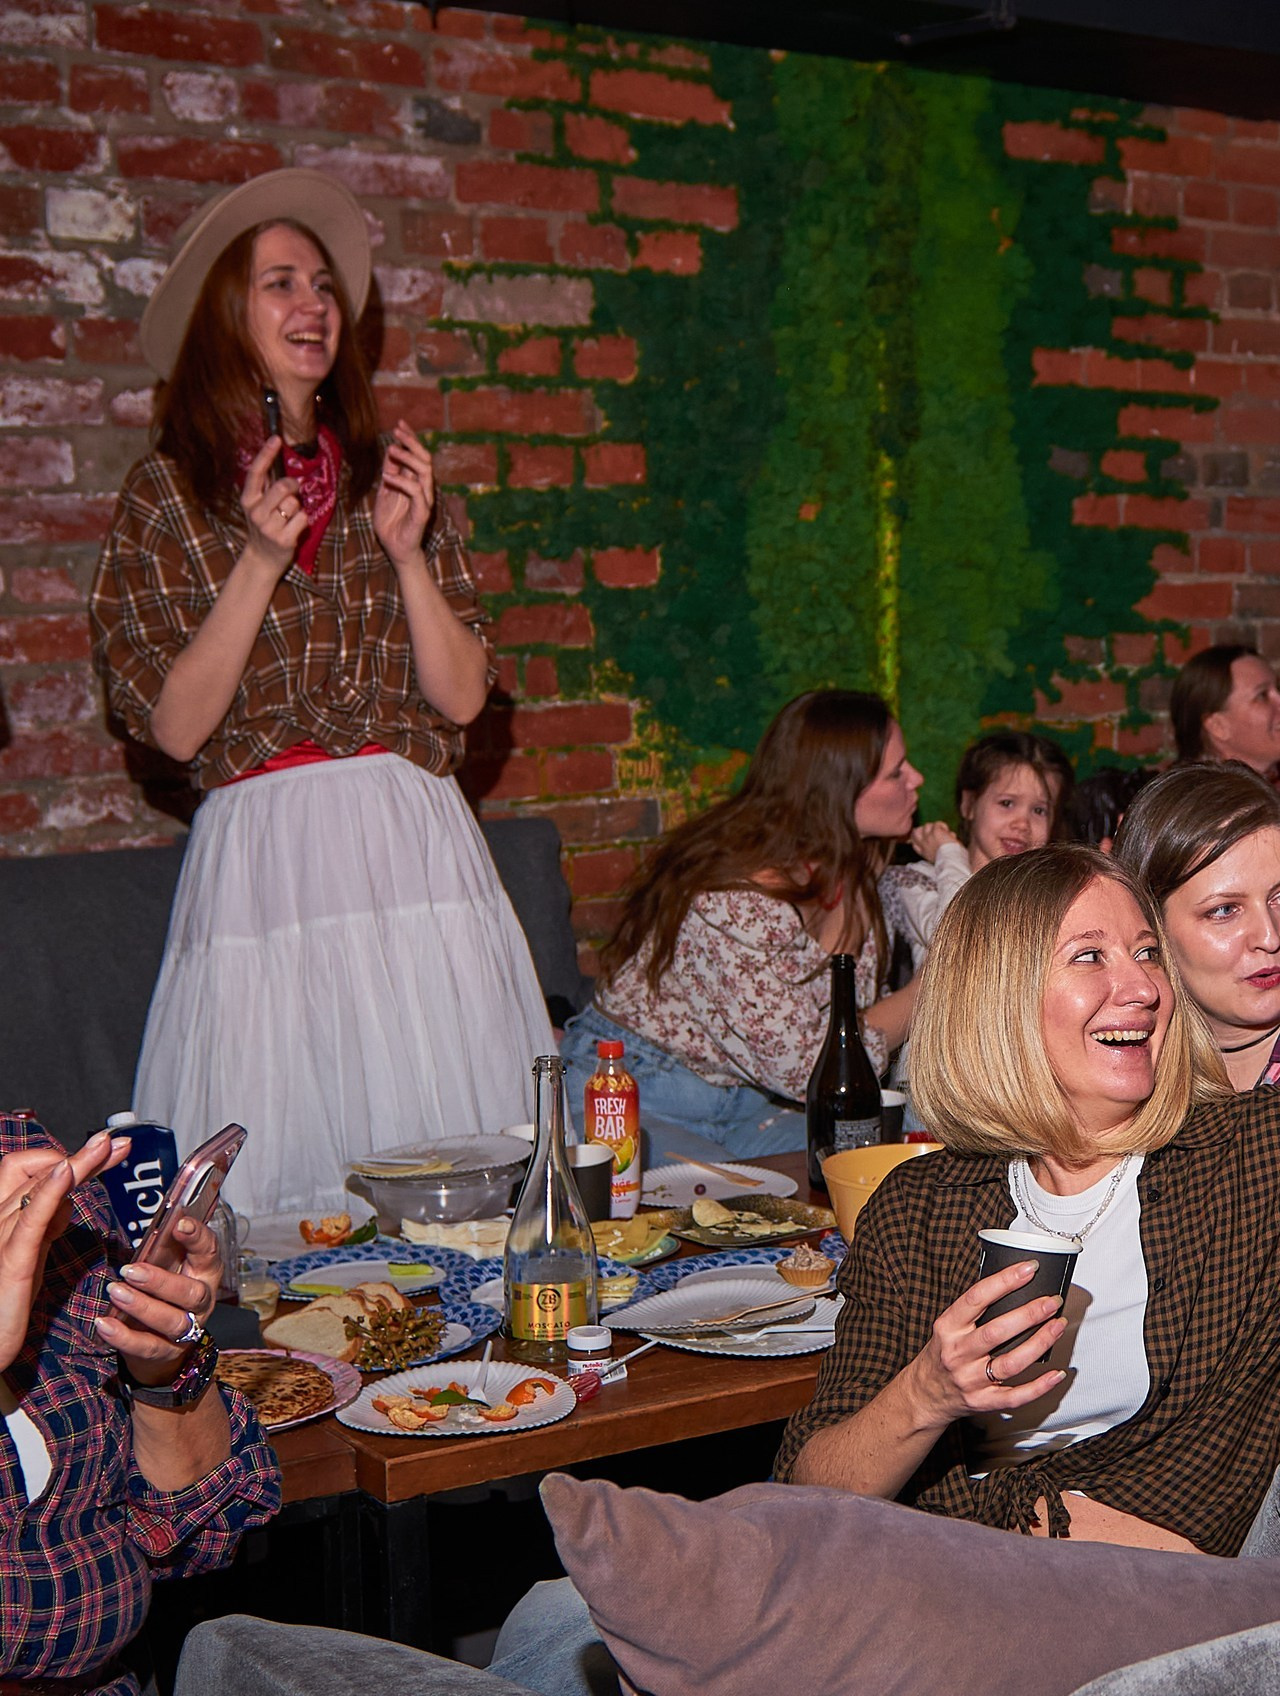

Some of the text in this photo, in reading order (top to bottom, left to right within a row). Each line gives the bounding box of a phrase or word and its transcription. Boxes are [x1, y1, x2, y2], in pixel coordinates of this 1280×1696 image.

[594, 1097, 626, 1115] FRESH
[594, 1115, 626, 1140] BAR
[123, 1159, 164, 1249] ich
[541, 1293, 557, 1304] ZB
[528, 1321, 571, 1329] MOSCATO
